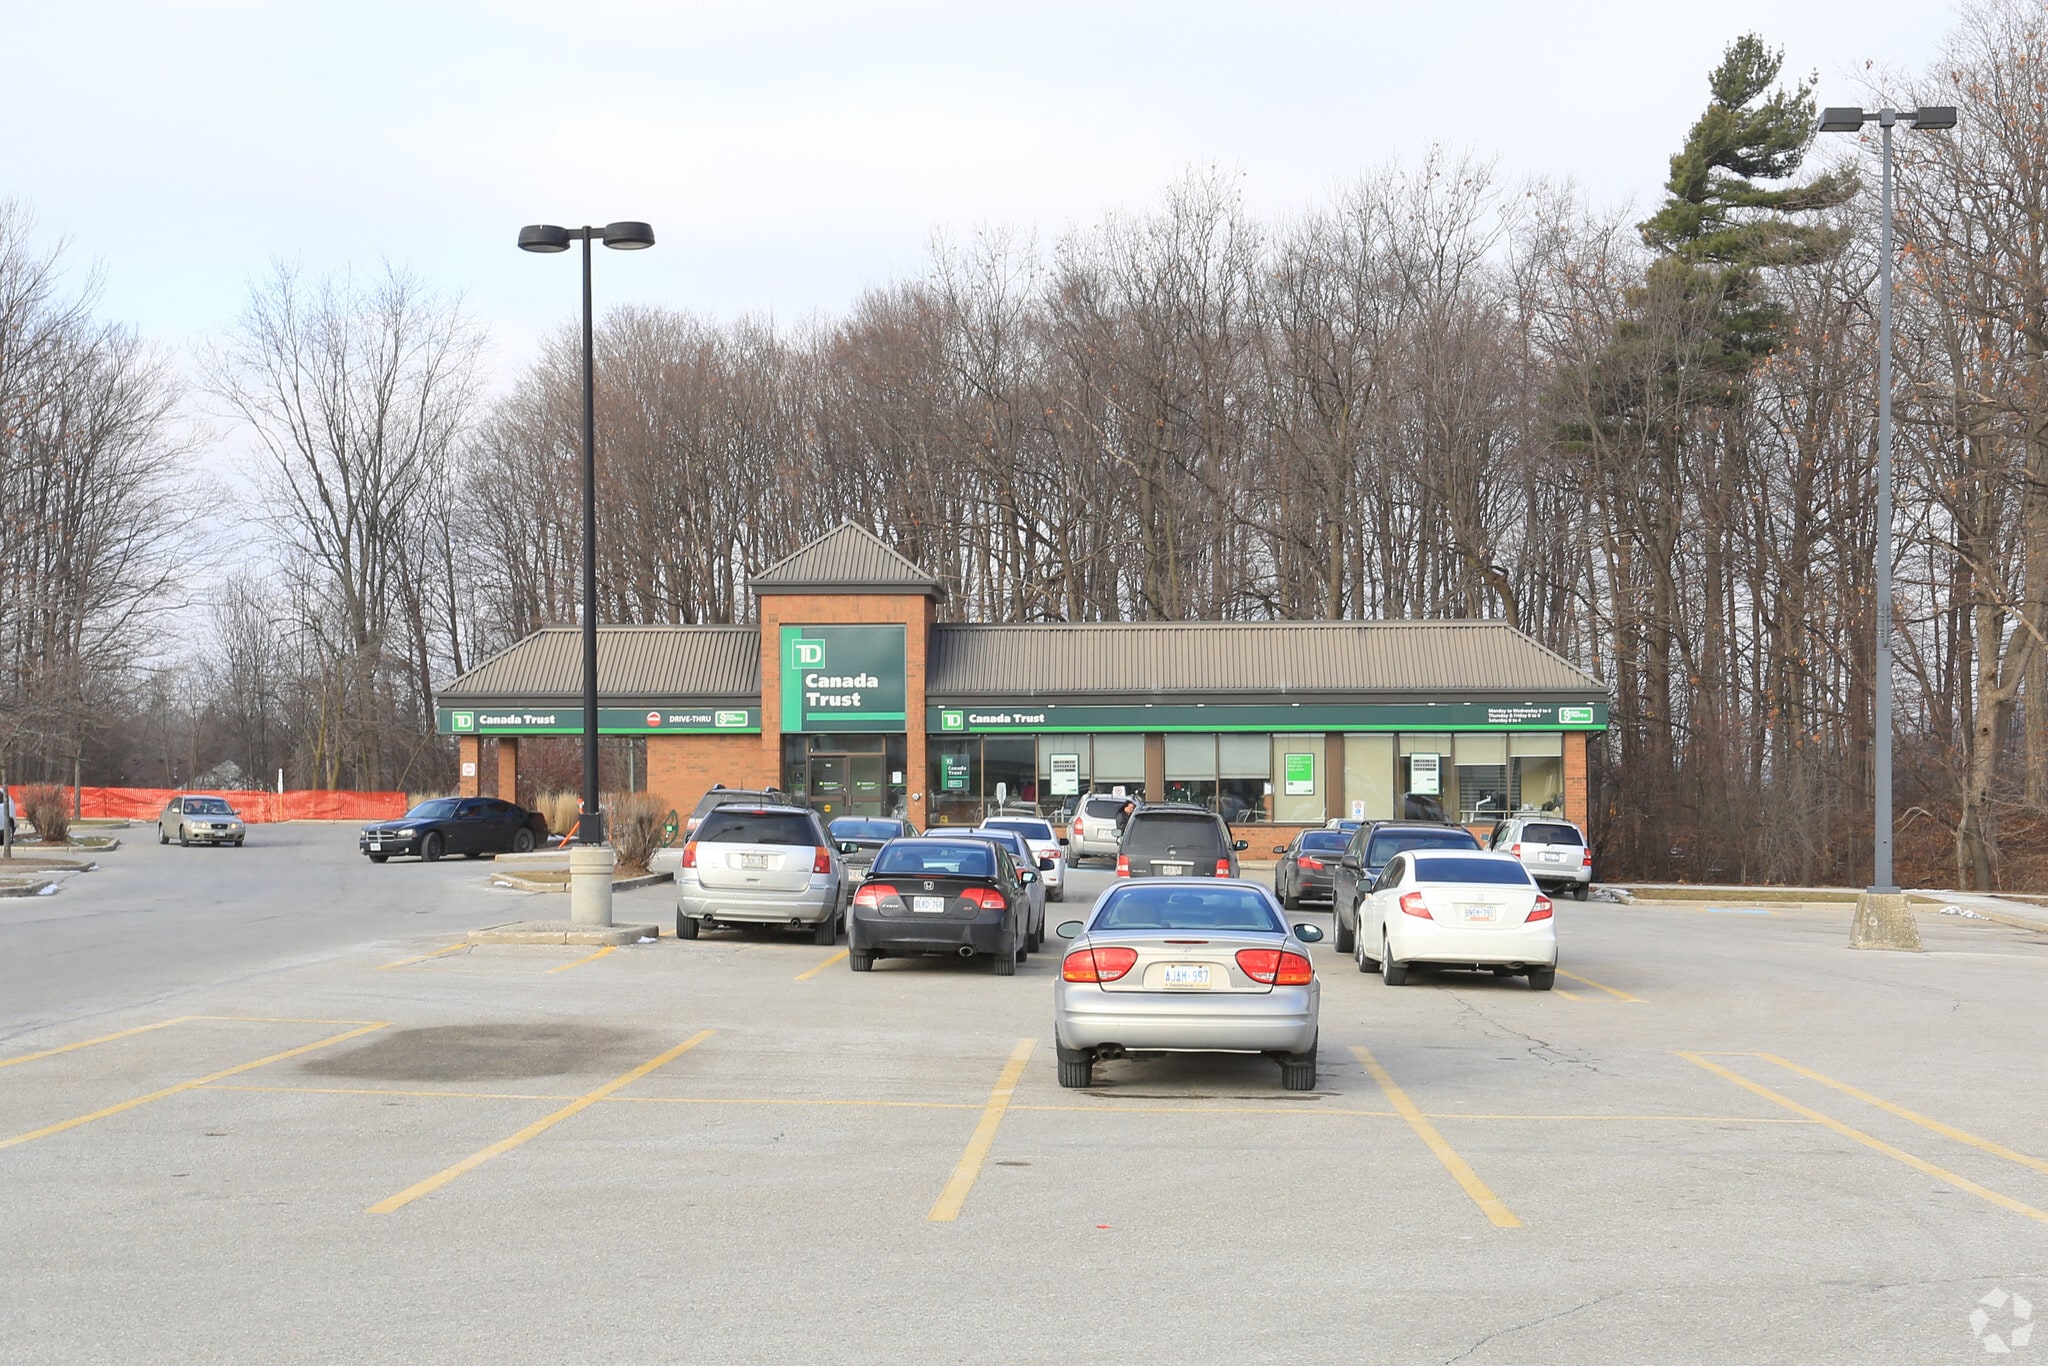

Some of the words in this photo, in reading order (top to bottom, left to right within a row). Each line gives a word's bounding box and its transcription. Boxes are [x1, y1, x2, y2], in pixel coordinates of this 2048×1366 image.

[795, 644, 822, 663] TD
[805, 672, 879, 688] Canada
[805, 691, 861, 707] Trust
[454, 714, 471, 728] TD
[479, 714, 522, 725] Canada
[523, 714, 556, 725] Trust
[669, 715, 711, 723] DRIVE-THRU
[943, 714, 960, 727] TD
[969, 713, 1011, 723] Canada
[1012, 713, 1045, 723] Trust
